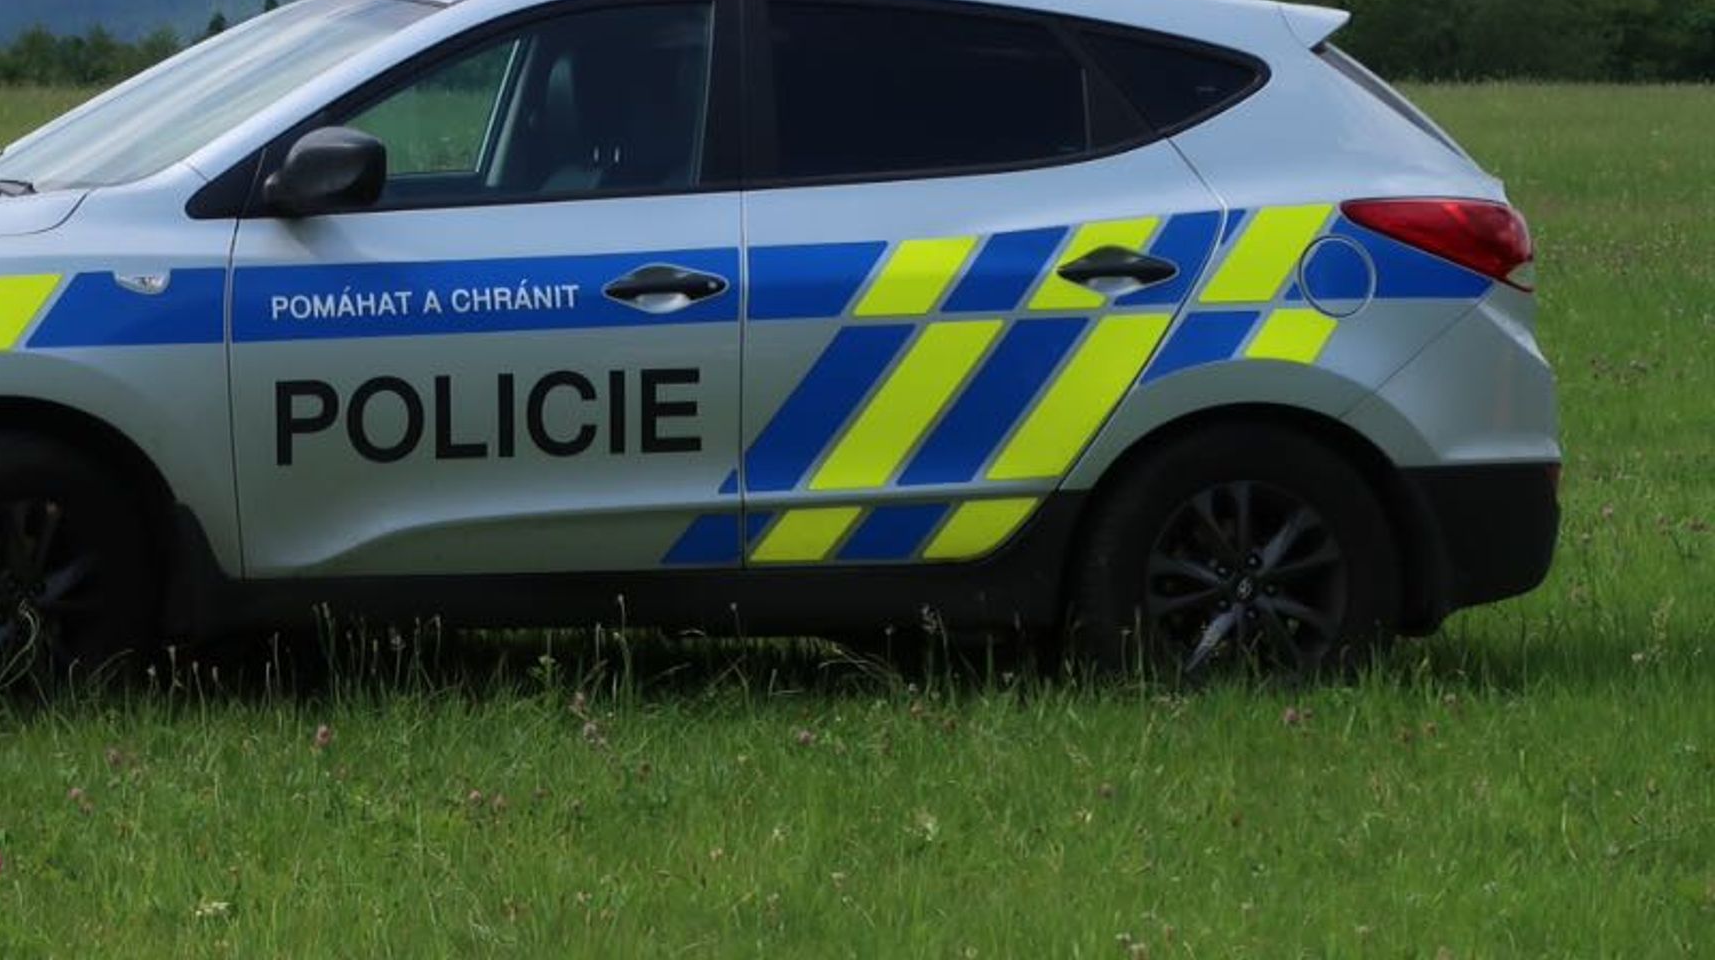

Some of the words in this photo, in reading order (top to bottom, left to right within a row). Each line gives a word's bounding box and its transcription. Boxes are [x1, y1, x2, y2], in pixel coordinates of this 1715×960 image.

[272, 287, 412, 319] POMÁHAT
[423, 290, 442, 313] A
[451, 279, 579, 312] CHRÁNIT
[275, 367, 703, 466] POLICIE
